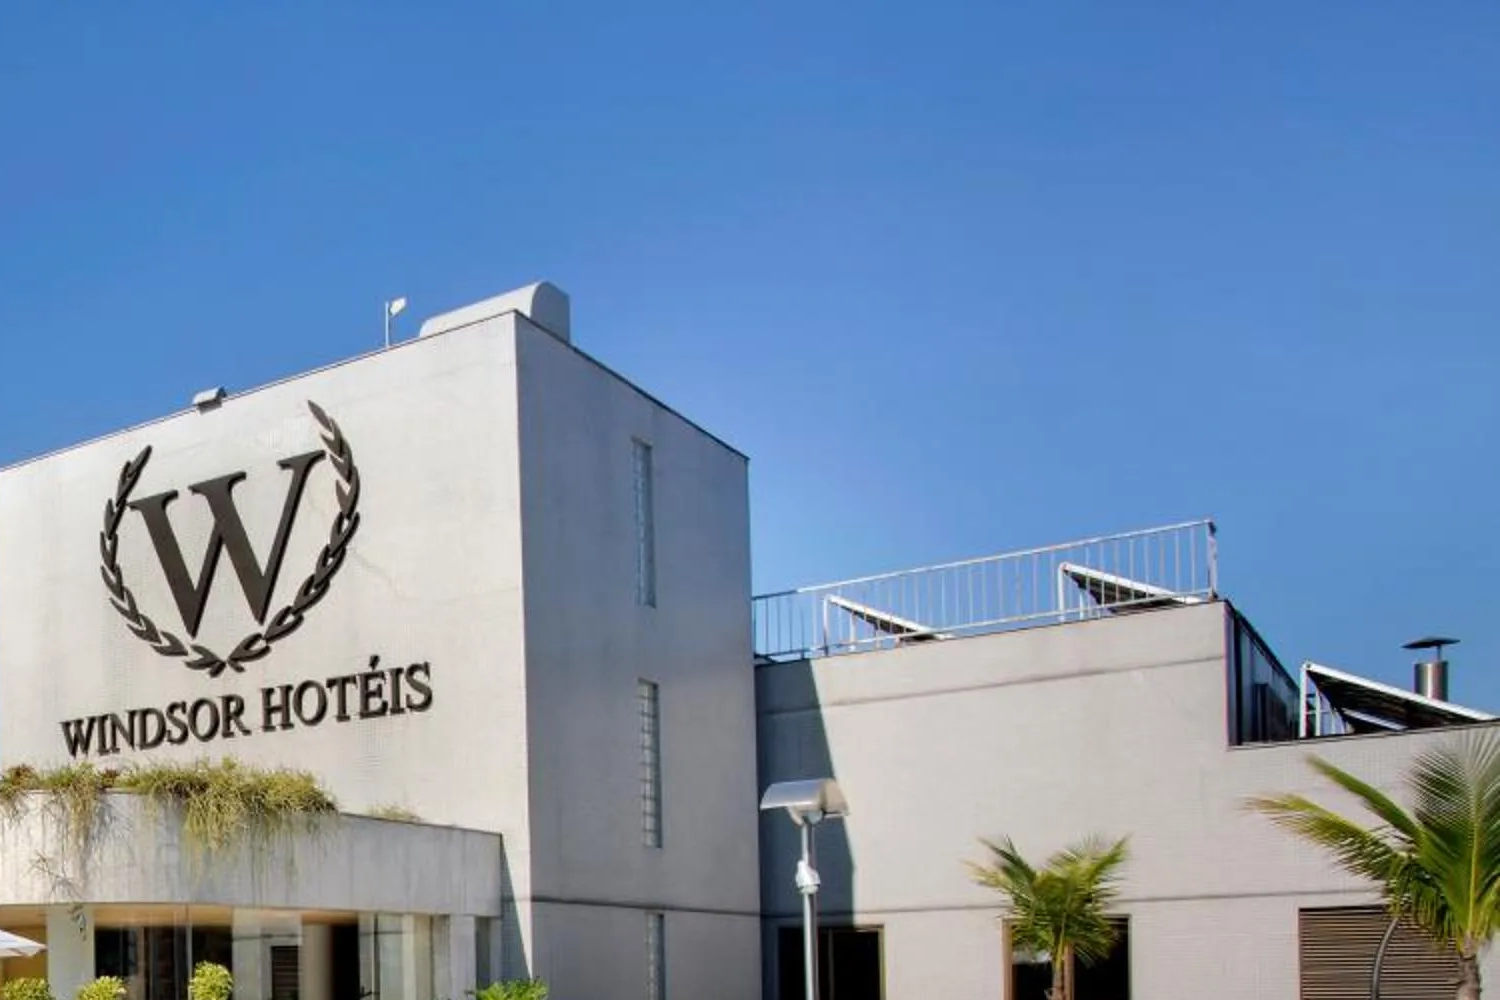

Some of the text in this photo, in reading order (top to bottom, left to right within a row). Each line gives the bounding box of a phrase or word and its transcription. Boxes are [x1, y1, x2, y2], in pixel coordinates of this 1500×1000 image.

[128, 449, 326, 639] W
[60, 655, 435, 758] WINDSOR HOTÉIS
